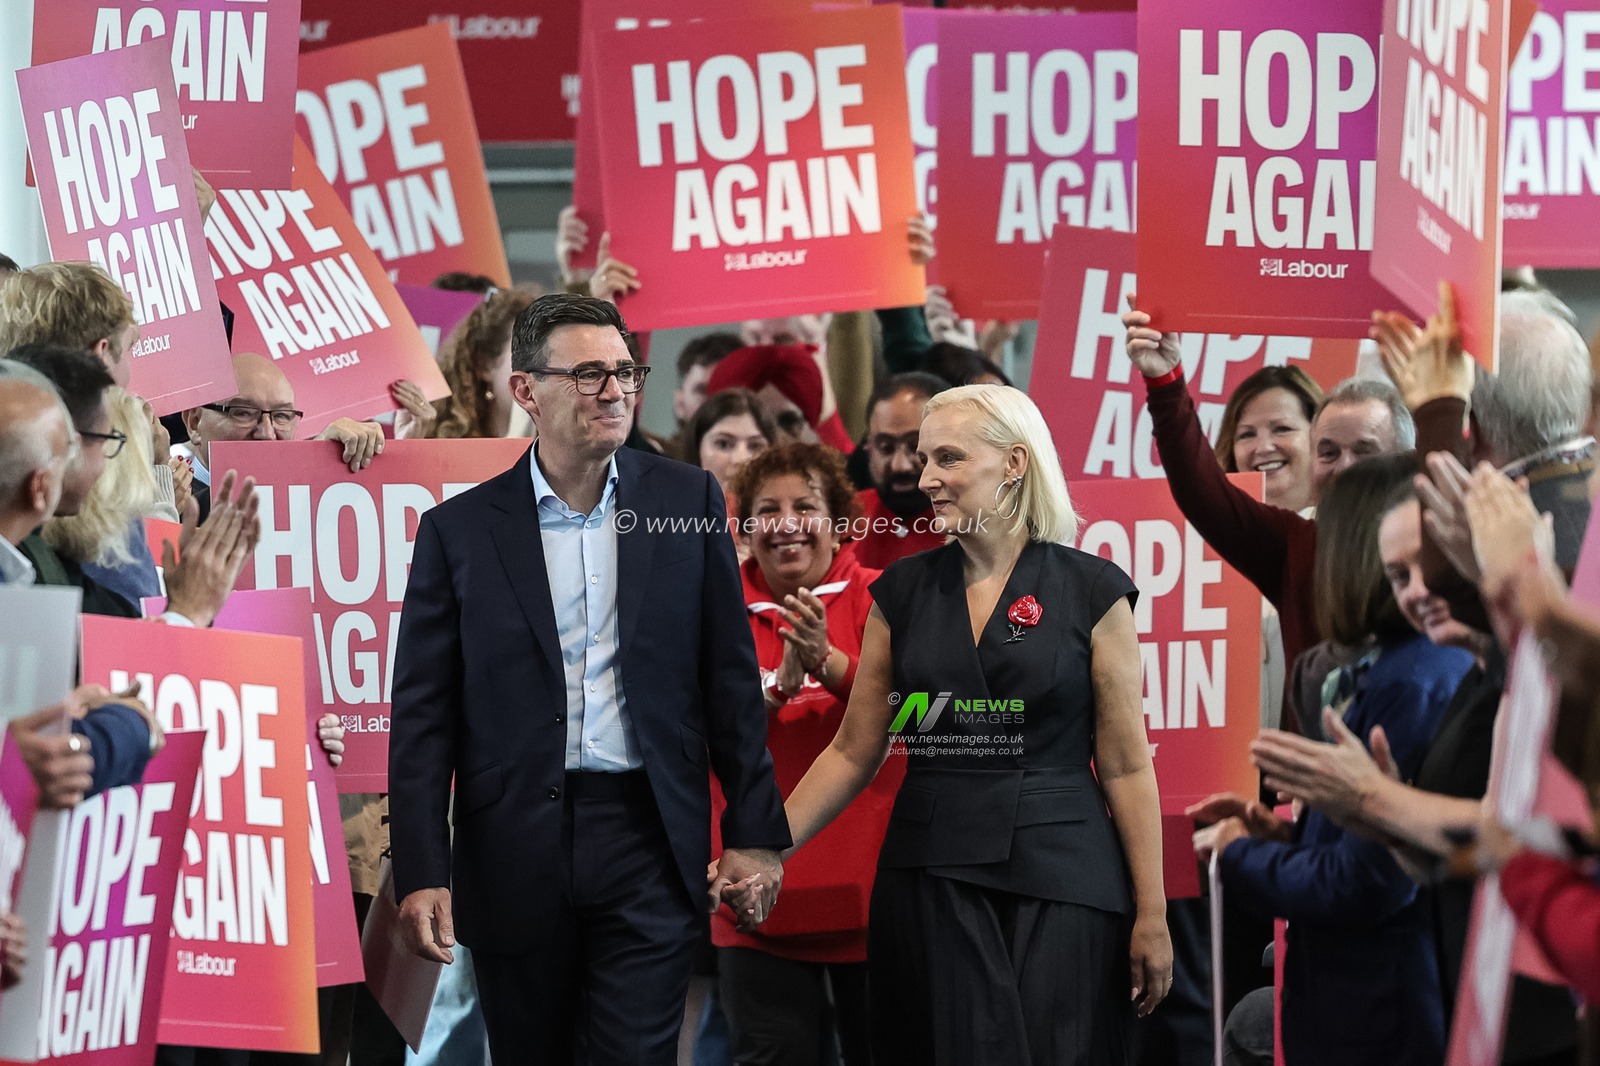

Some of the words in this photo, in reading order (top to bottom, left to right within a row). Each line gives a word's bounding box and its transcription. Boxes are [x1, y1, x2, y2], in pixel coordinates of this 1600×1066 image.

[632, 44, 875, 168] HOPE
[972, 49, 1138, 157] HOP
[1179, 29, 1384, 151] HOP
[1509, 10, 1600, 112] PE
[44, 88, 180, 234] HOPE
[295, 64, 445, 186] OPE
[1400, 56, 1488, 241] AGAIN
[1504, 116, 1600, 195] AIN
[352, 168, 464, 262] AIN
[672, 153, 882, 251] AGAIN
[996, 160, 1137, 243] AGA
[1205, 156, 1377, 251] AGAI
[237, 253, 392, 360] AGAIN
[741, 249, 808, 270] Labour
[1277, 258, 1348, 280] Labour
[141, 333, 171, 357] Labour
[318, 350, 361, 374] Labour
[1070, 268, 1313, 396] HP
[253, 482, 482, 605] HOP
[1079, 519, 1228, 634] PE
[358, 714, 391, 733] Lab
[1140, 639, 1228, 730] AIN
[109, 669, 284, 827] PE
[168, 828, 289, 946] GAIN
[188, 950, 236, 977] Labour
